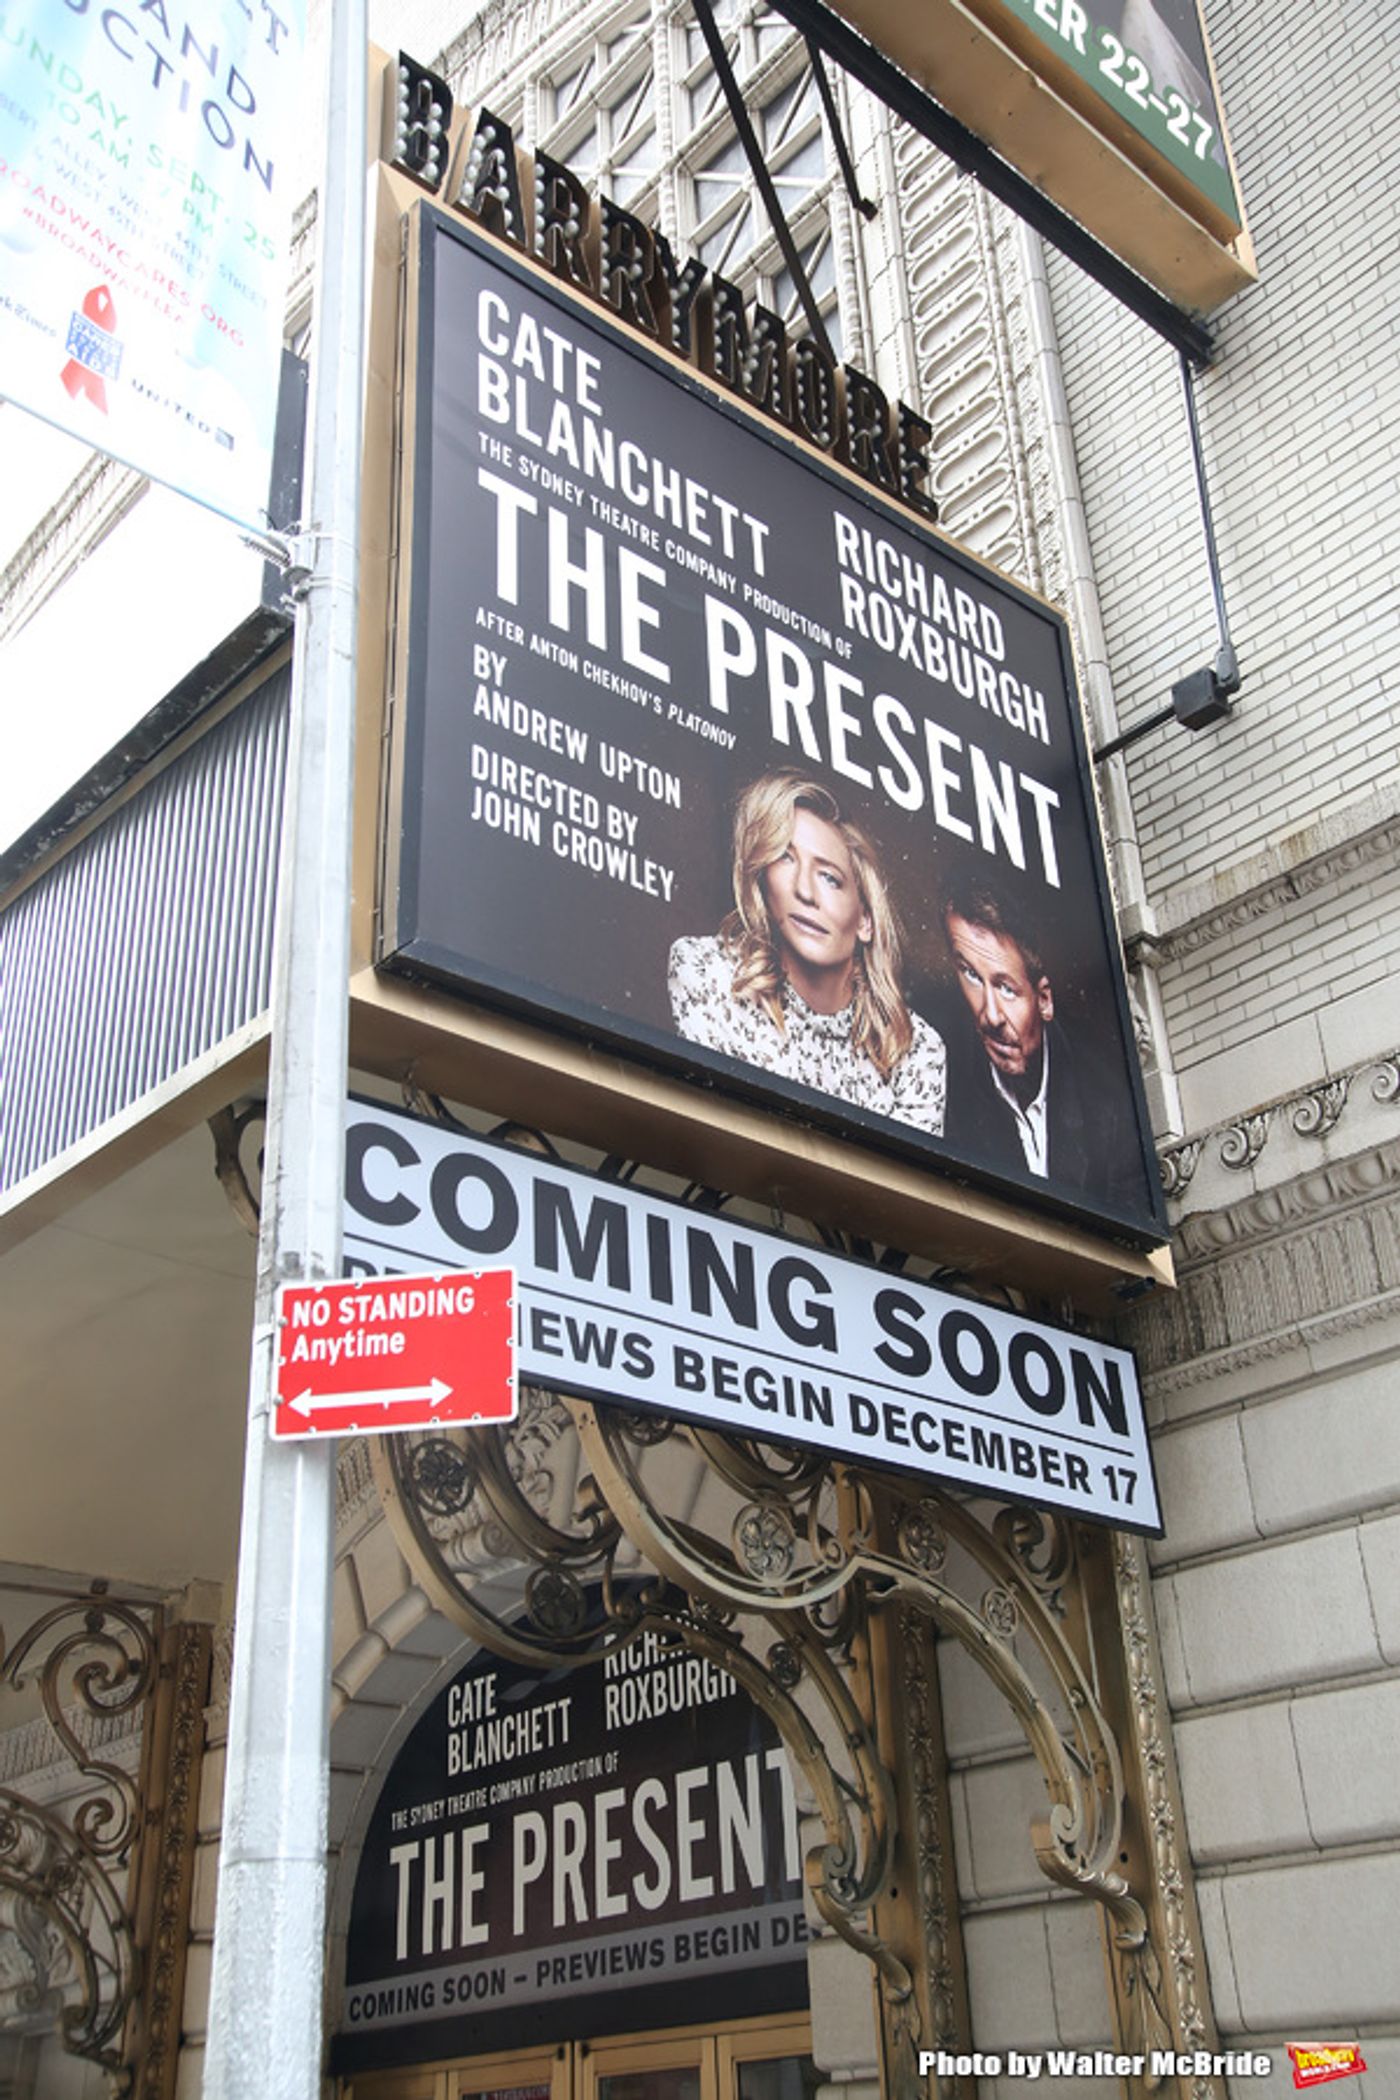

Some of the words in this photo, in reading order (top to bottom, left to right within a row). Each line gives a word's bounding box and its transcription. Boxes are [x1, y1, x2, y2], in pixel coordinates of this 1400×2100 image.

[64, 0, 274, 193] CTION
[1099, 33, 1213, 160] 22-27
[88, 129, 130, 170] AM
[182, 197, 214, 238] PM
[243, 221, 276, 262] 25
[398, 48, 938, 520] BARRYMORE
[131, 378, 212, 434] UNITED
[478, 289, 602, 416] CATE
[478, 353, 770, 577] BLANCHETT
[478, 432, 512, 468] THE
[518, 453, 584, 507] SYDNEY
[590, 494, 660, 552] THEATRE
[665, 538, 737, 594] COMPANY
[743, 583, 832, 649] PRODUCTION
[835, 633, 853, 660] OF
[833, 511, 1006, 662] RICHARD
[473, 643, 508, 687] BY
[476, 606, 524, 646] AFTER
[529, 636, 578, 675] ANTON
[582, 660, 662, 715] CHEKHOV'S
[667, 702, 737, 751] PLATONOV
[478, 466, 671, 684] THE
[704, 593, 1061, 889] PRESENT
[840, 572, 1050, 746] ROXBURGH
[471, 744, 599, 830] DIRECTED
[607, 804, 638, 847] BY
[473, 684, 588, 764] ANDREW
[600, 741, 681, 809] UPTON
[471, 786, 541, 846] JOHN
[553, 821, 675, 902] CROWLEY
[291, 1298, 330, 1328] NO
[338, 1286, 475, 1324] STANDING
[345, 1121, 838, 1353] COMING
[874, 1288, 1131, 1437] SOON
[291, 1330, 406, 1366] Anytime
[674, 1345, 834, 1427] BEGIN
[848, 1393, 1092, 1494] DECEMBER
[1103, 1464, 1138, 1504] 17
[447, 1673, 498, 1728] CATE
[447, 1697, 572, 1777] BLANCHETT
[390, 1822, 491, 1961] THE
[513, 1747, 801, 1936] PRESENT
[391, 1810, 408, 1832] THE
[410, 1799, 445, 1827] SYDNEY
[448, 1787, 487, 1817] THEATRE
[489, 1773, 536, 1806] COMPANY
[538, 1756, 601, 1791] PRODUCTION
[604, 1750, 620, 1774] OF
[349, 1980, 436, 2022] COMING
[442, 1968, 506, 2006] SOON
[536, 1938, 665, 1988] PREVIEWS
[674, 1921, 761, 1963] BEGIN
